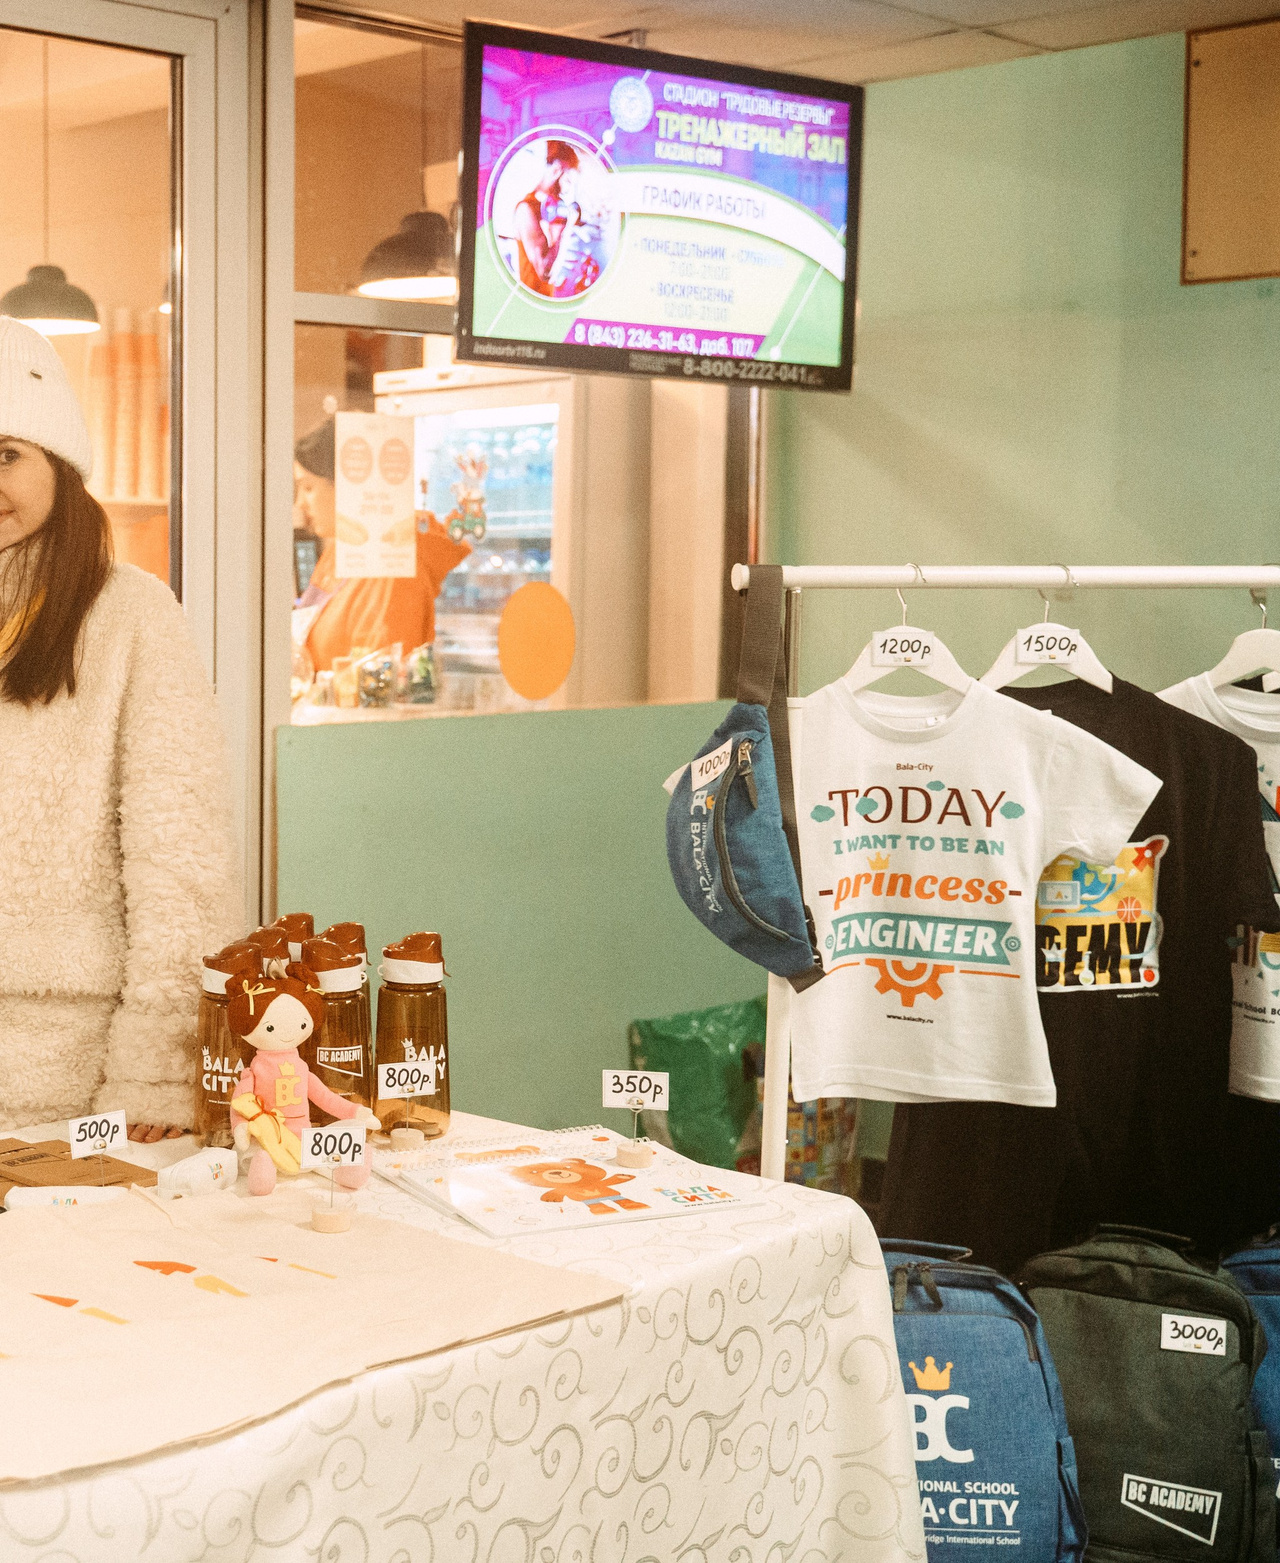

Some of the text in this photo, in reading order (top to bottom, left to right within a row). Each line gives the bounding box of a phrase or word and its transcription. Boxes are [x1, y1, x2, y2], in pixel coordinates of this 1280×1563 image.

[663, 82, 720, 108] СТАДИОН
[655, 110, 846, 165] ТРЕНАЖЕРНЫЙ ЗАЛ
[642, 185, 766, 219] ГРАФИК РАБОТЫ
[641, 237, 726, 261] ПОНЕДЕЛЬНИК
[574, 323, 586, 343] 8
[587, 324, 626, 349] (843)
[896, 763, 934, 772] Bala-City
[828, 786, 1006, 828] TODAY
[833, 834, 1005, 856] I WANT TO BE AN
[834, 872, 1008, 911] princess
[835, 918, 998, 958] ENGINEER
[203, 1054, 245, 1074] BALA
[319, 1048, 361, 1062] BC ACADEMY
[405, 1043, 446, 1062] BALA
[903, 1393, 975, 1463] BC
[920, 1480, 1020, 1496] IONAL SCHOOL
[1128, 1481, 1215, 1516] BC ACADEMY
[925, 1534, 1021, 1547] ridge International School
